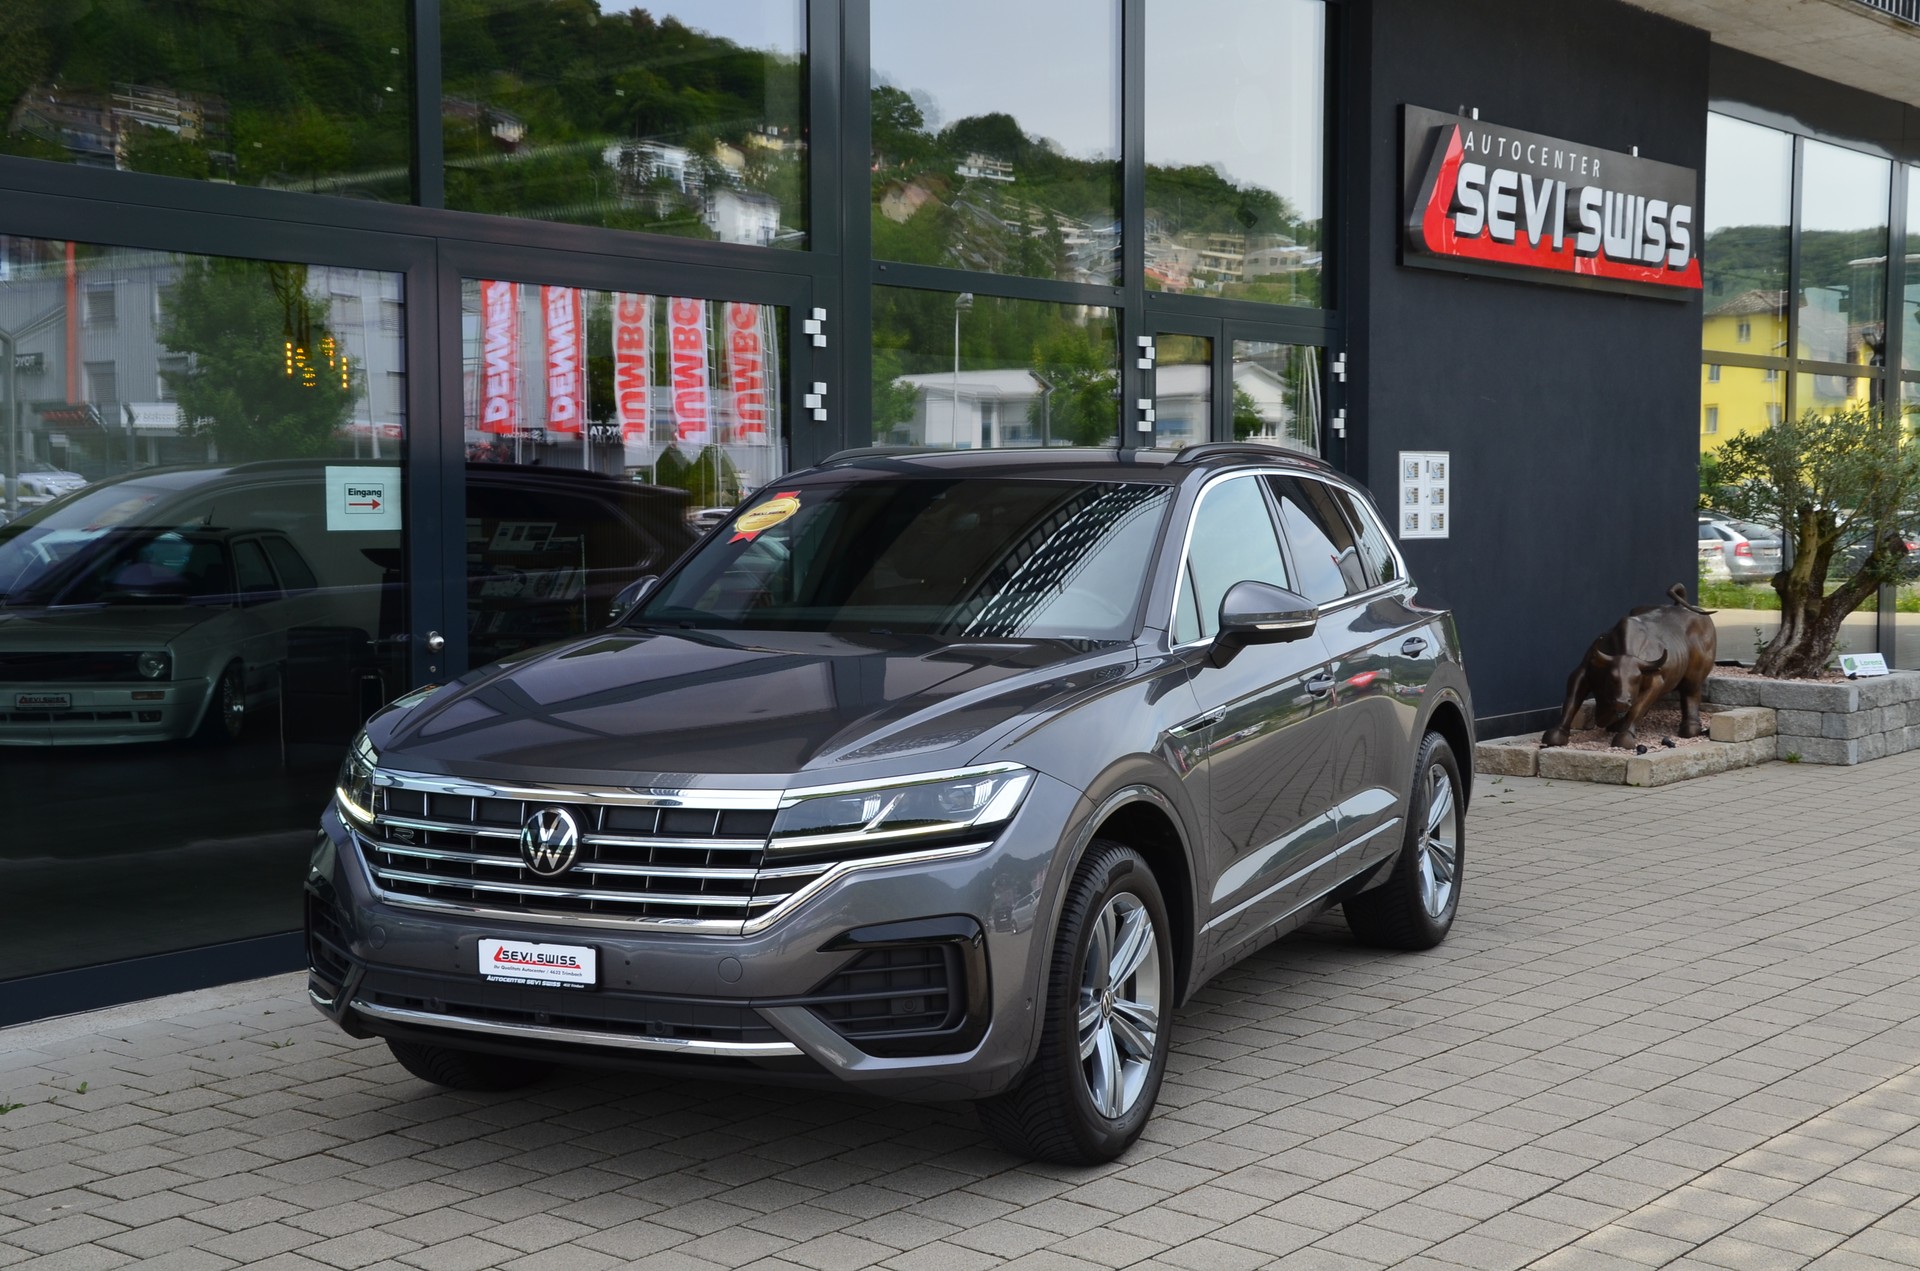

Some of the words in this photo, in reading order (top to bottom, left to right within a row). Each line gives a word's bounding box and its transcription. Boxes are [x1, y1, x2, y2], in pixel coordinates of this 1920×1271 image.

[1464, 130, 1600, 178] AUTOCENTER
[1455, 161, 1567, 249] SEVI
[1576, 185, 1692, 268] SWISS
[348, 488, 382, 498] Eingang
[502, 950, 533, 962] SEVI
[537, 953, 577, 966] SWISS
